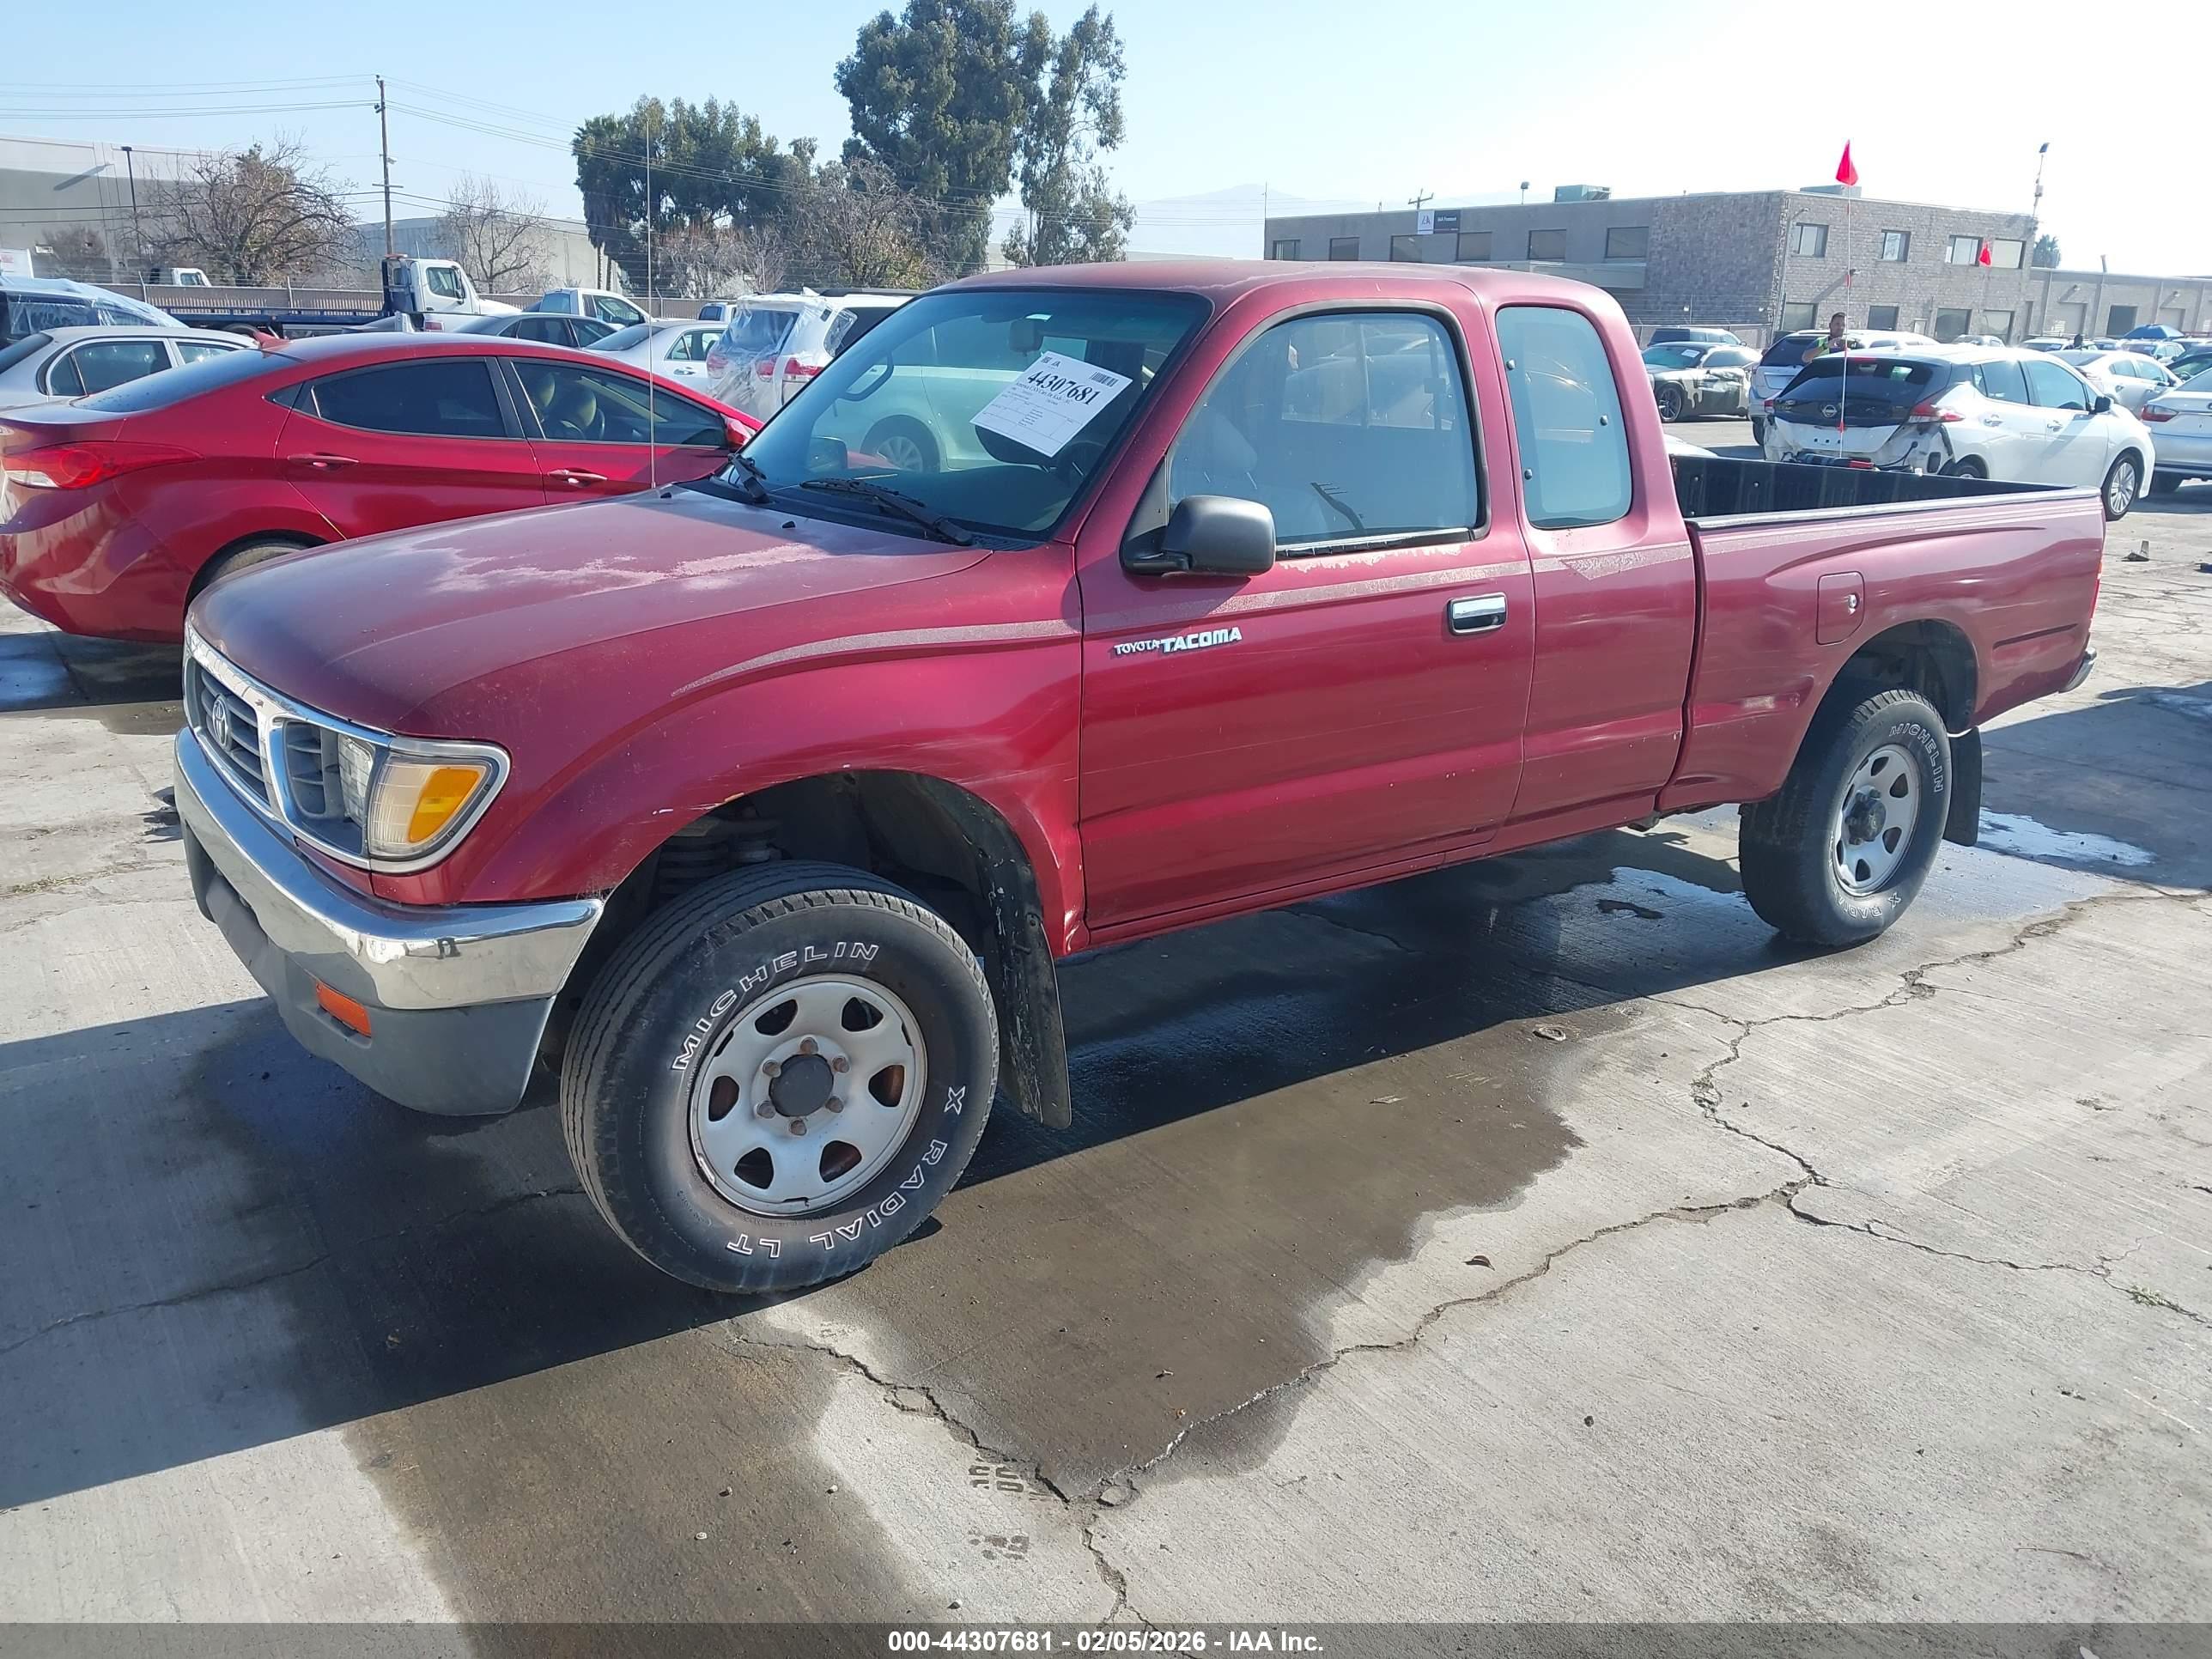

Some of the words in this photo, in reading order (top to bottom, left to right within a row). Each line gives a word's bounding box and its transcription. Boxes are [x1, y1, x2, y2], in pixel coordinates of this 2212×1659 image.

[1027, 370, 1101, 405] 44307681
[1114, 639, 1160, 655] TOYOTA
[1159, 626, 1243, 653] TACOMA
[1888, 722, 1944, 793] MICHELIN
[671, 941, 880, 1071] MICHELIN
[944, 1085, 966, 1115] X
[809, 1139, 949, 1251] RADIAL
[726, 1233, 781, 1258] LT
